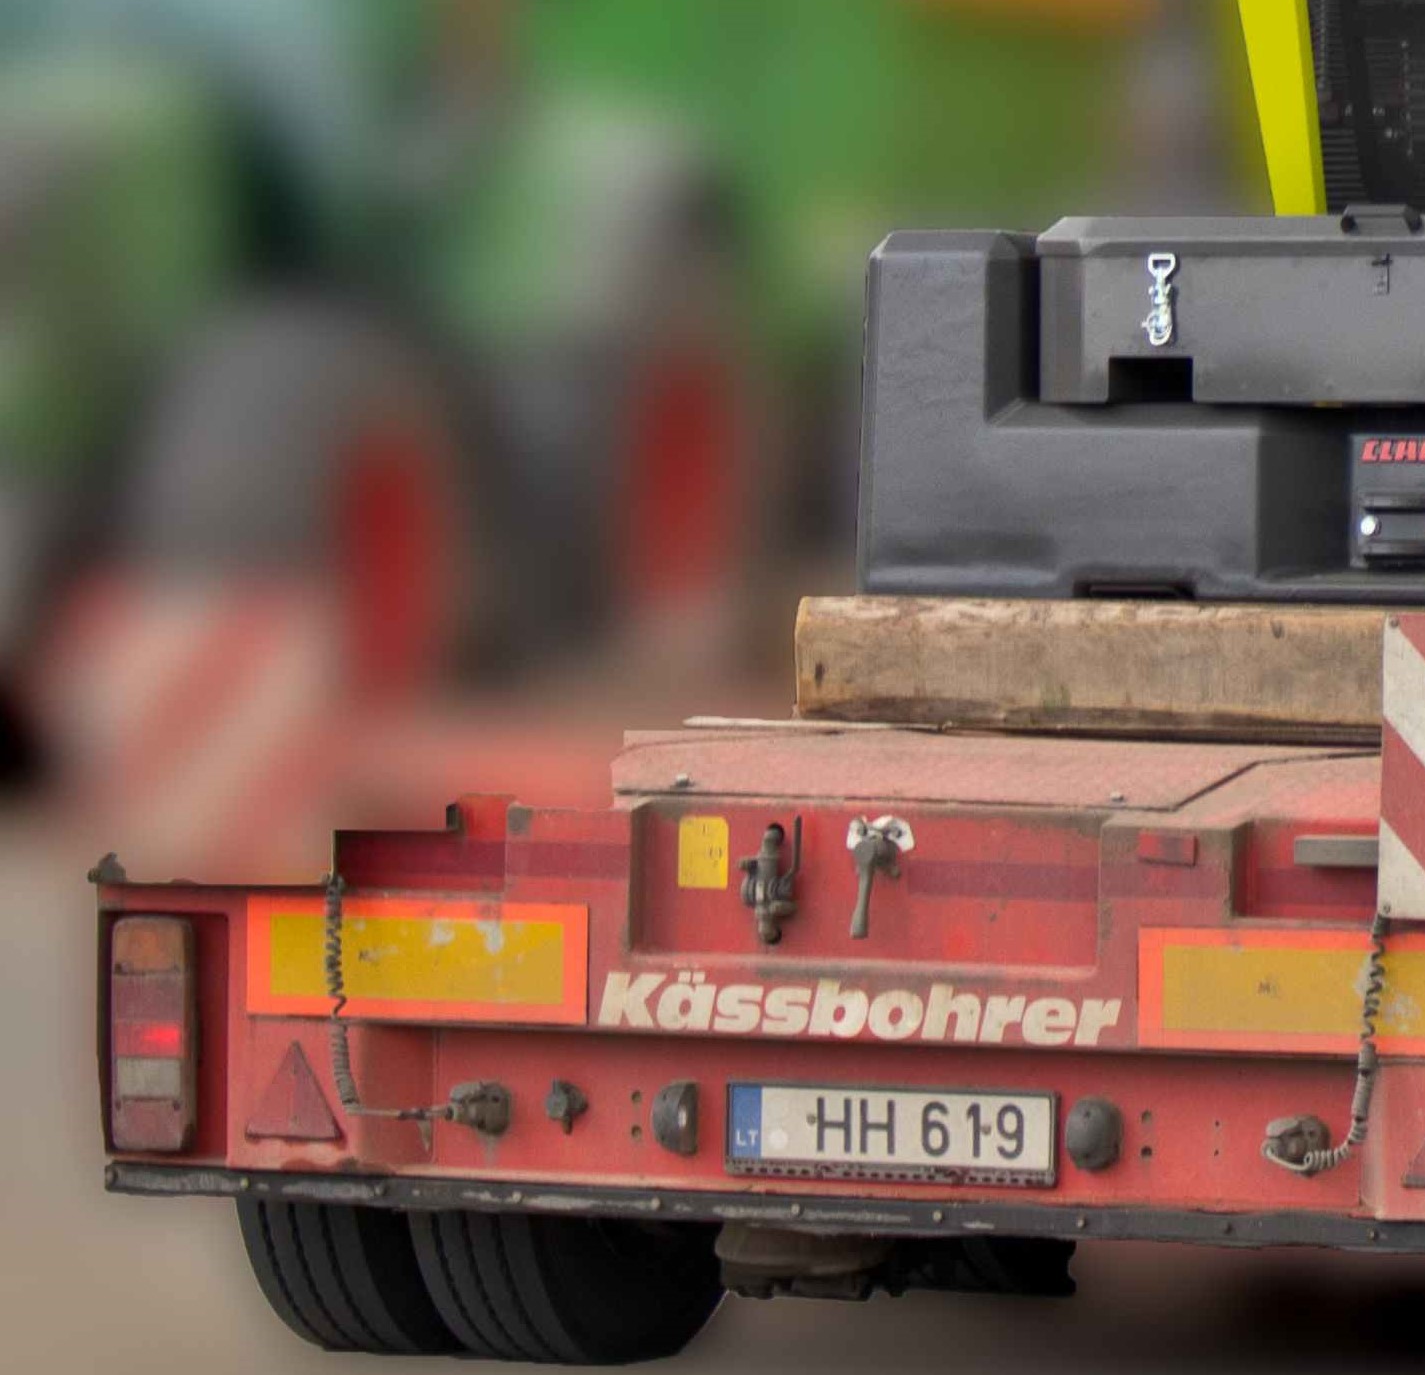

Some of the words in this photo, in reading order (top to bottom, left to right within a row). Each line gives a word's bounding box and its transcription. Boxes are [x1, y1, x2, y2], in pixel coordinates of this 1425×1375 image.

[598, 972, 1122, 1047] Kässbohrer
[736, 1130, 758, 1146] LT
[816, 1096, 895, 1155] HH
[921, 1101, 1024, 1159] 619
